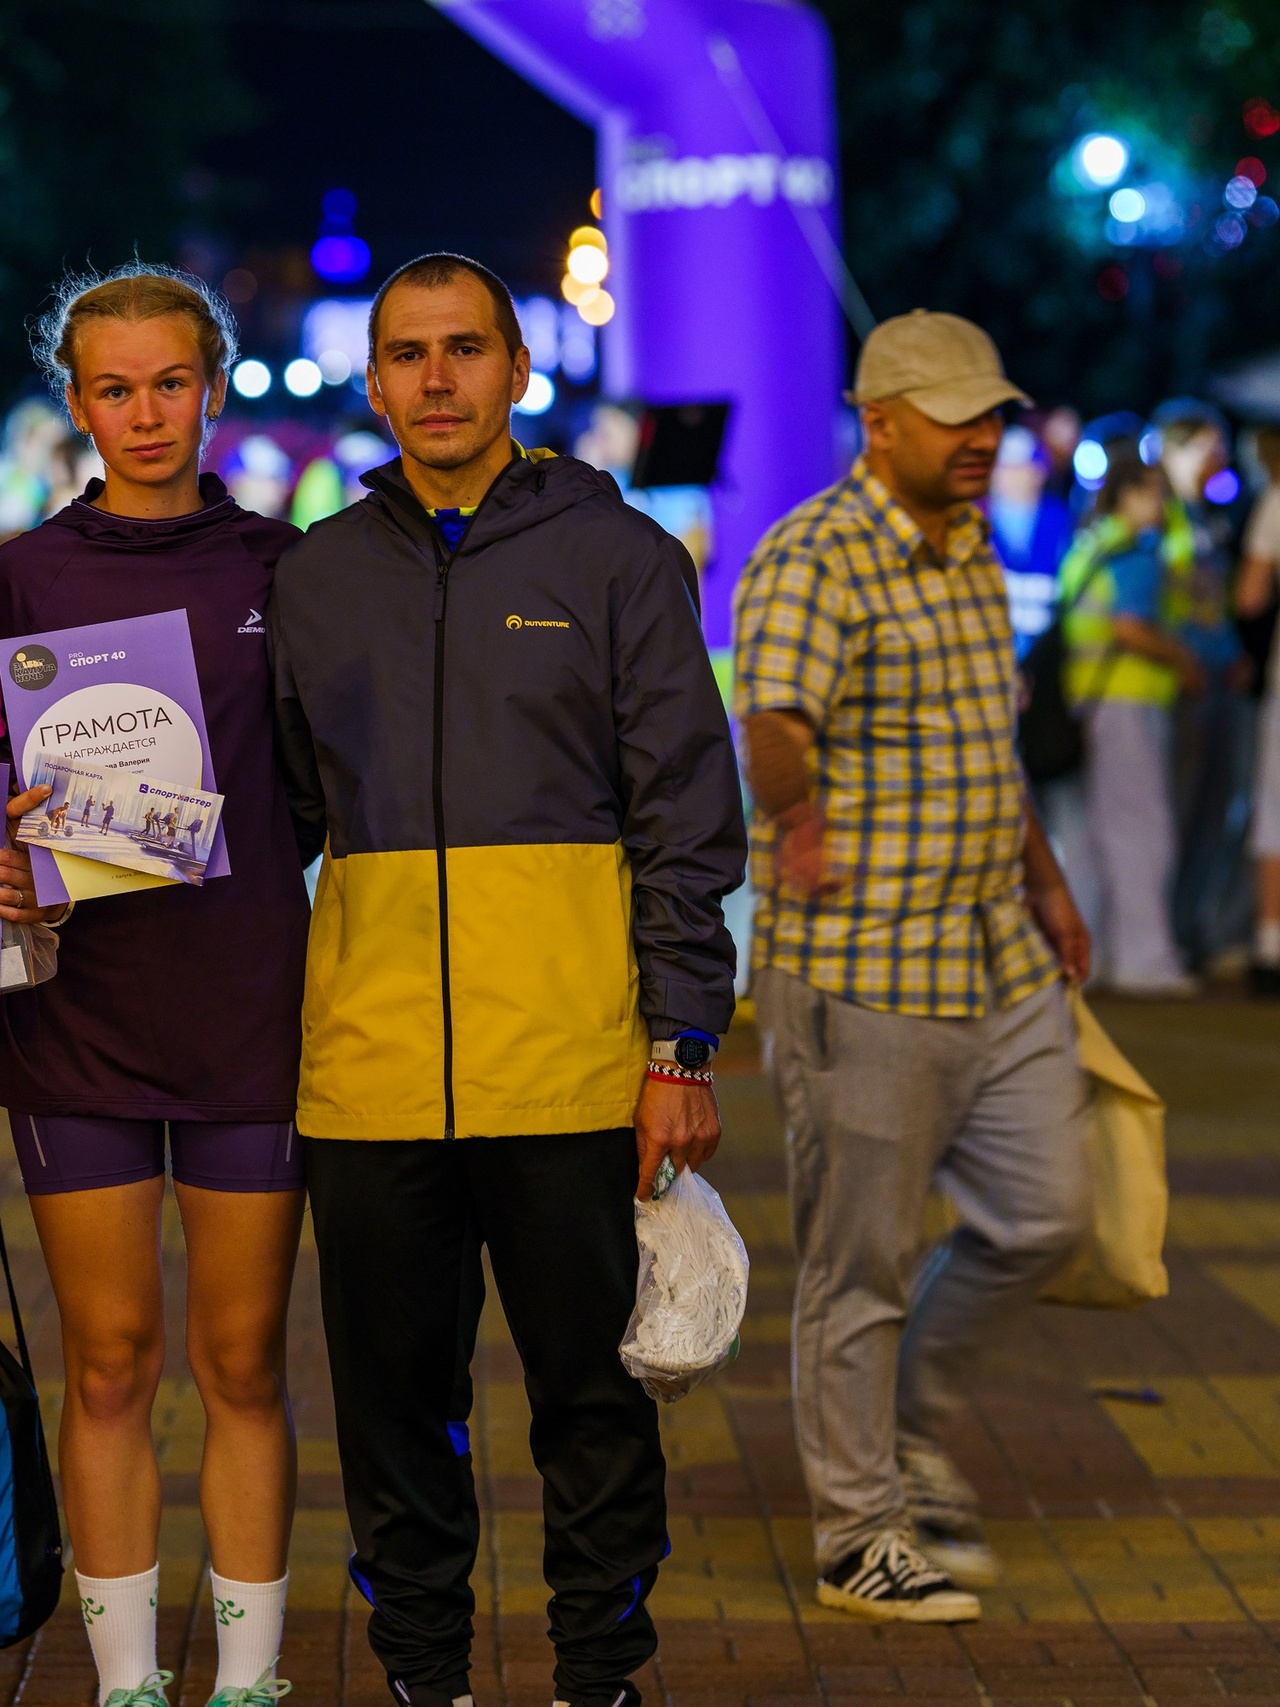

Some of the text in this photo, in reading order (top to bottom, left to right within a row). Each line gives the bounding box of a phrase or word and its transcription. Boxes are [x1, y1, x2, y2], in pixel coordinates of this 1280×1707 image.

[524, 620, 570, 628] OUTVENTURE
[70, 651, 126, 667] СПОРТ 40
[39, 707, 173, 747] ГРАМОТА
[64, 737, 157, 759] НАГРАЖДАЕТСЯ
[44, 762, 104, 780] ПОДАРОЧНАЯ КАРТА
[119, 758, 151, 768] Валерия
[150, 788, 212, 808] спортмастер
